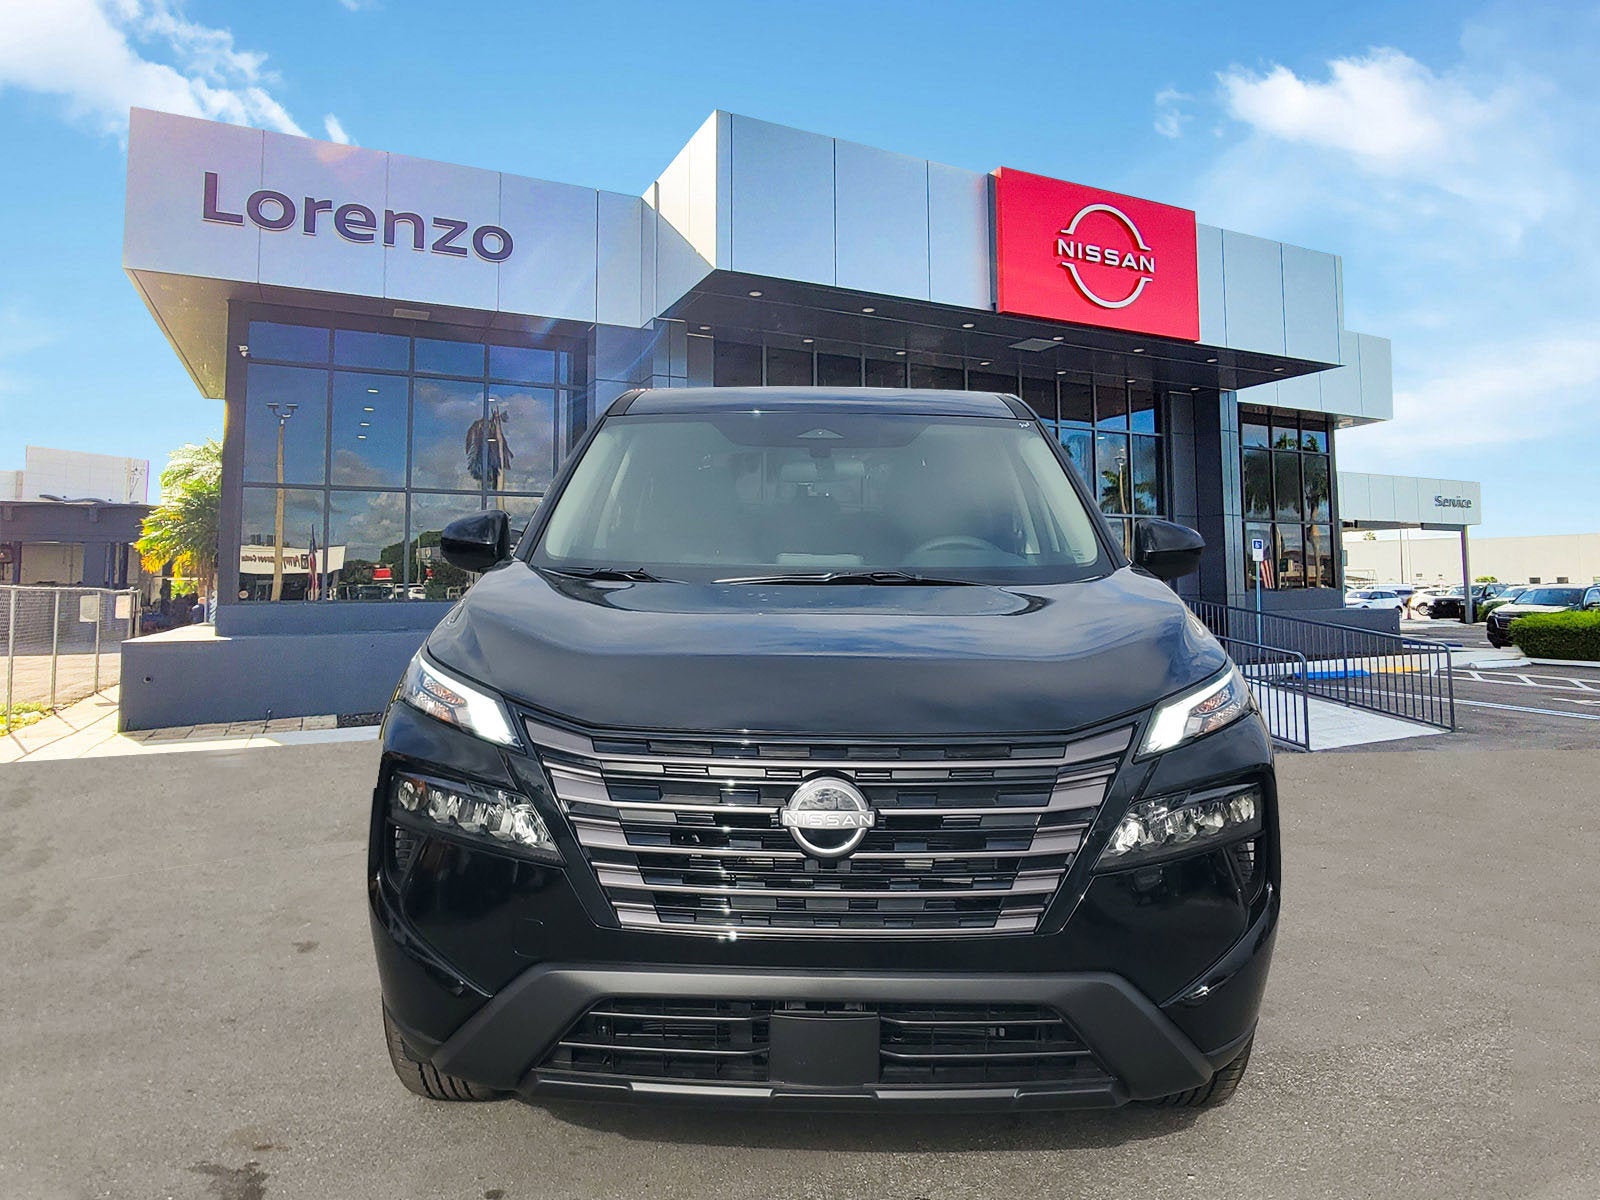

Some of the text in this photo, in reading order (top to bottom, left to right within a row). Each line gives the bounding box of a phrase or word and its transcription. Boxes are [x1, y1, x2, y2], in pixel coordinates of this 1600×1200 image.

[203, 171, 514, 262] Lorenzo
[1057, 238, 1155, 273] NISSAN
[1434, 495, 1472, 509] Service
[784, 813, 873, 827] NISSAN
